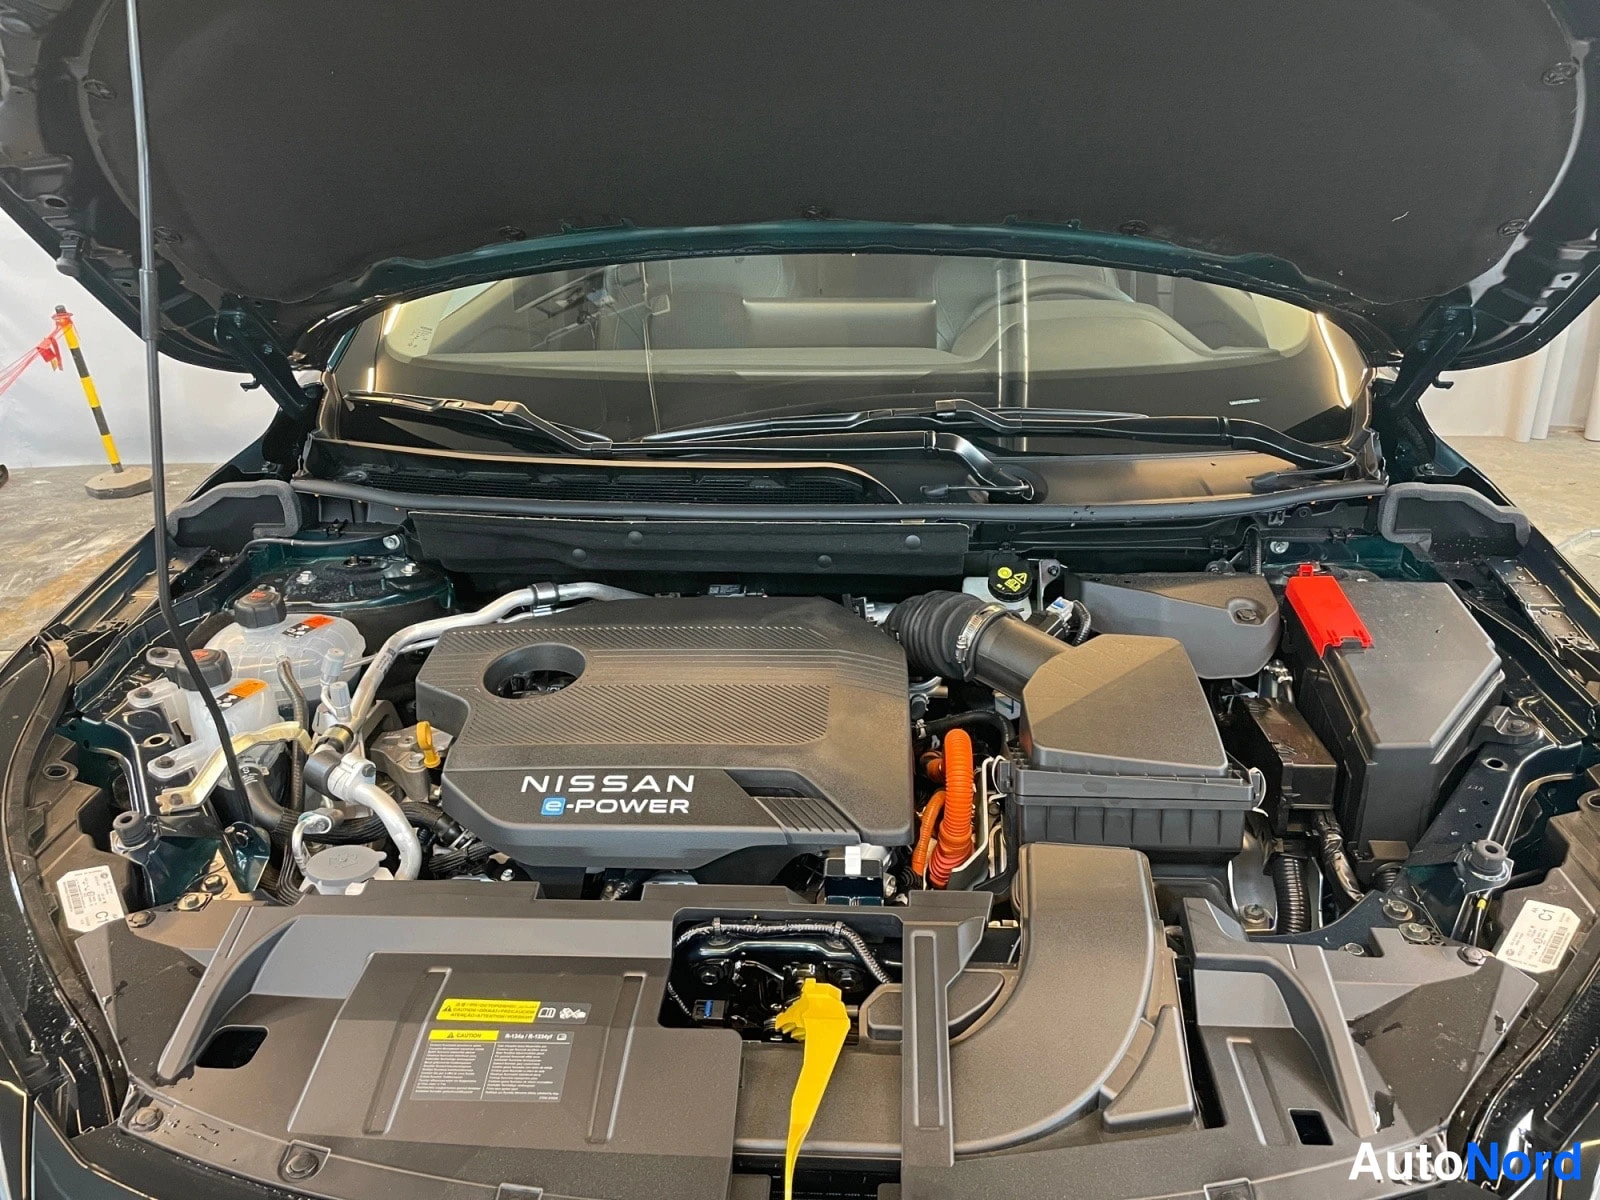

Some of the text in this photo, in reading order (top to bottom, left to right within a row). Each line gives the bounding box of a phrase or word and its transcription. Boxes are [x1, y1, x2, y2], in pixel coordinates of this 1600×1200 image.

[521, 775, 694, 793] NISSAN
[542, 798, 690, 815] e-POWER
[96, 911, 108, 923] C1
[1538, 909, 1555, 921] C1
